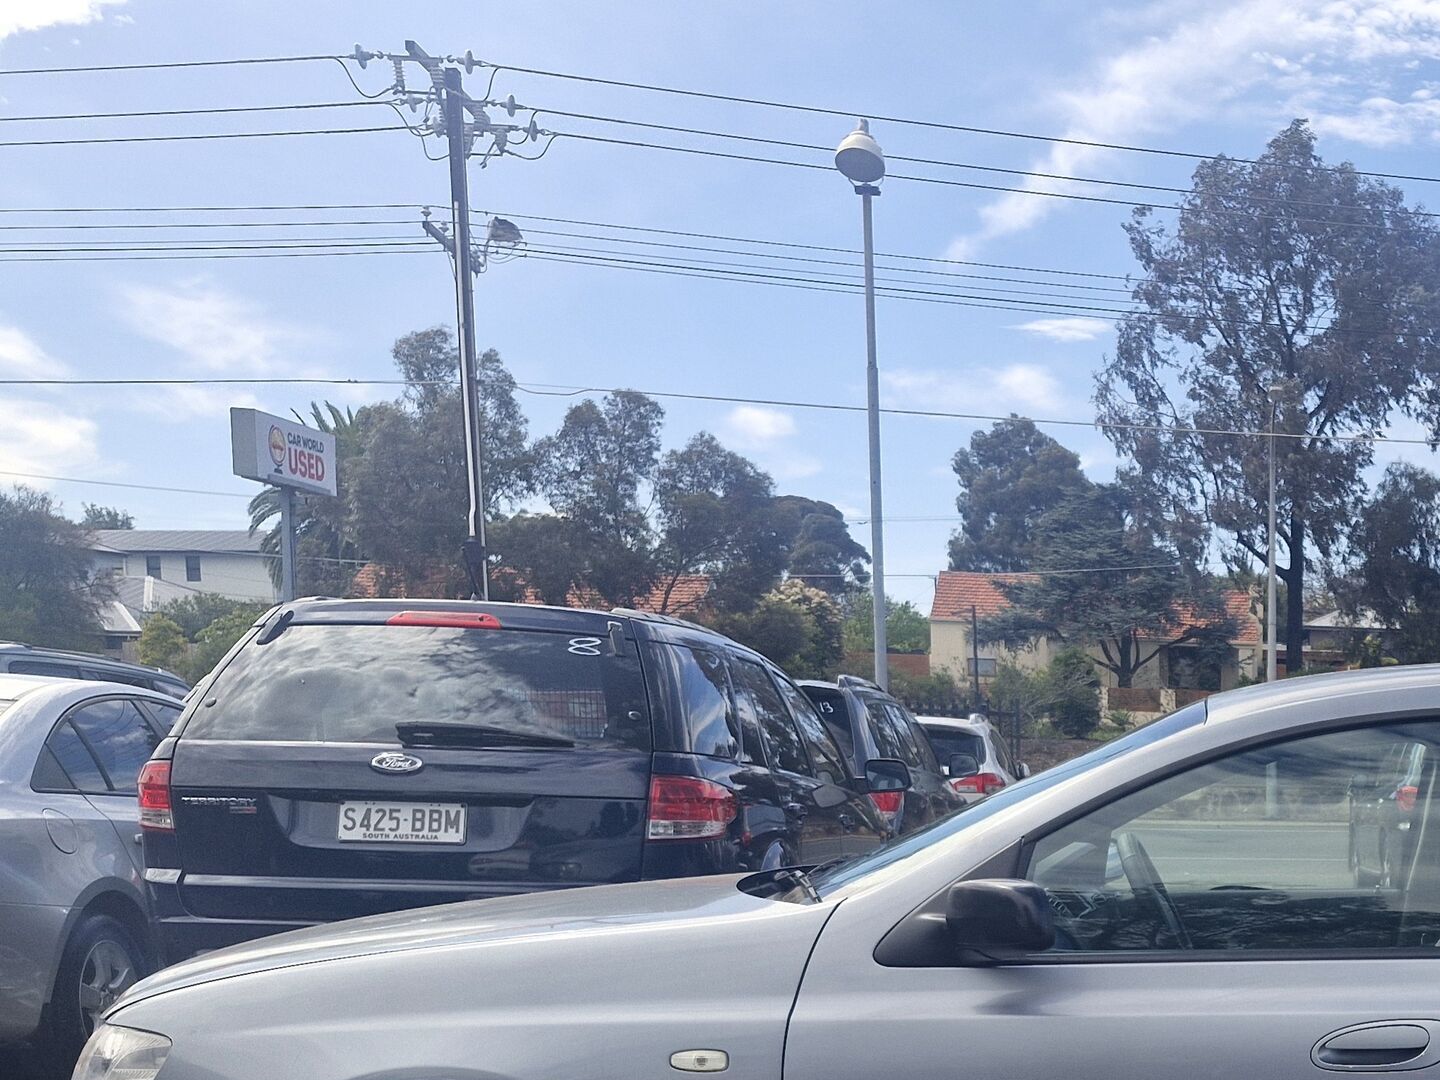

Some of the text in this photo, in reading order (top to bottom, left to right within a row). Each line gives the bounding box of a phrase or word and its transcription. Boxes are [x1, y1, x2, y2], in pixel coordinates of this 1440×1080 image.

[287, 432, 324, 453] CAR WORLD
[287, 447, 325, 481] USED
[568, 637, 602, 656] 8
[819, 701, 834, 713] 13
[393, 832, 439, 840] AUSTRALIA
